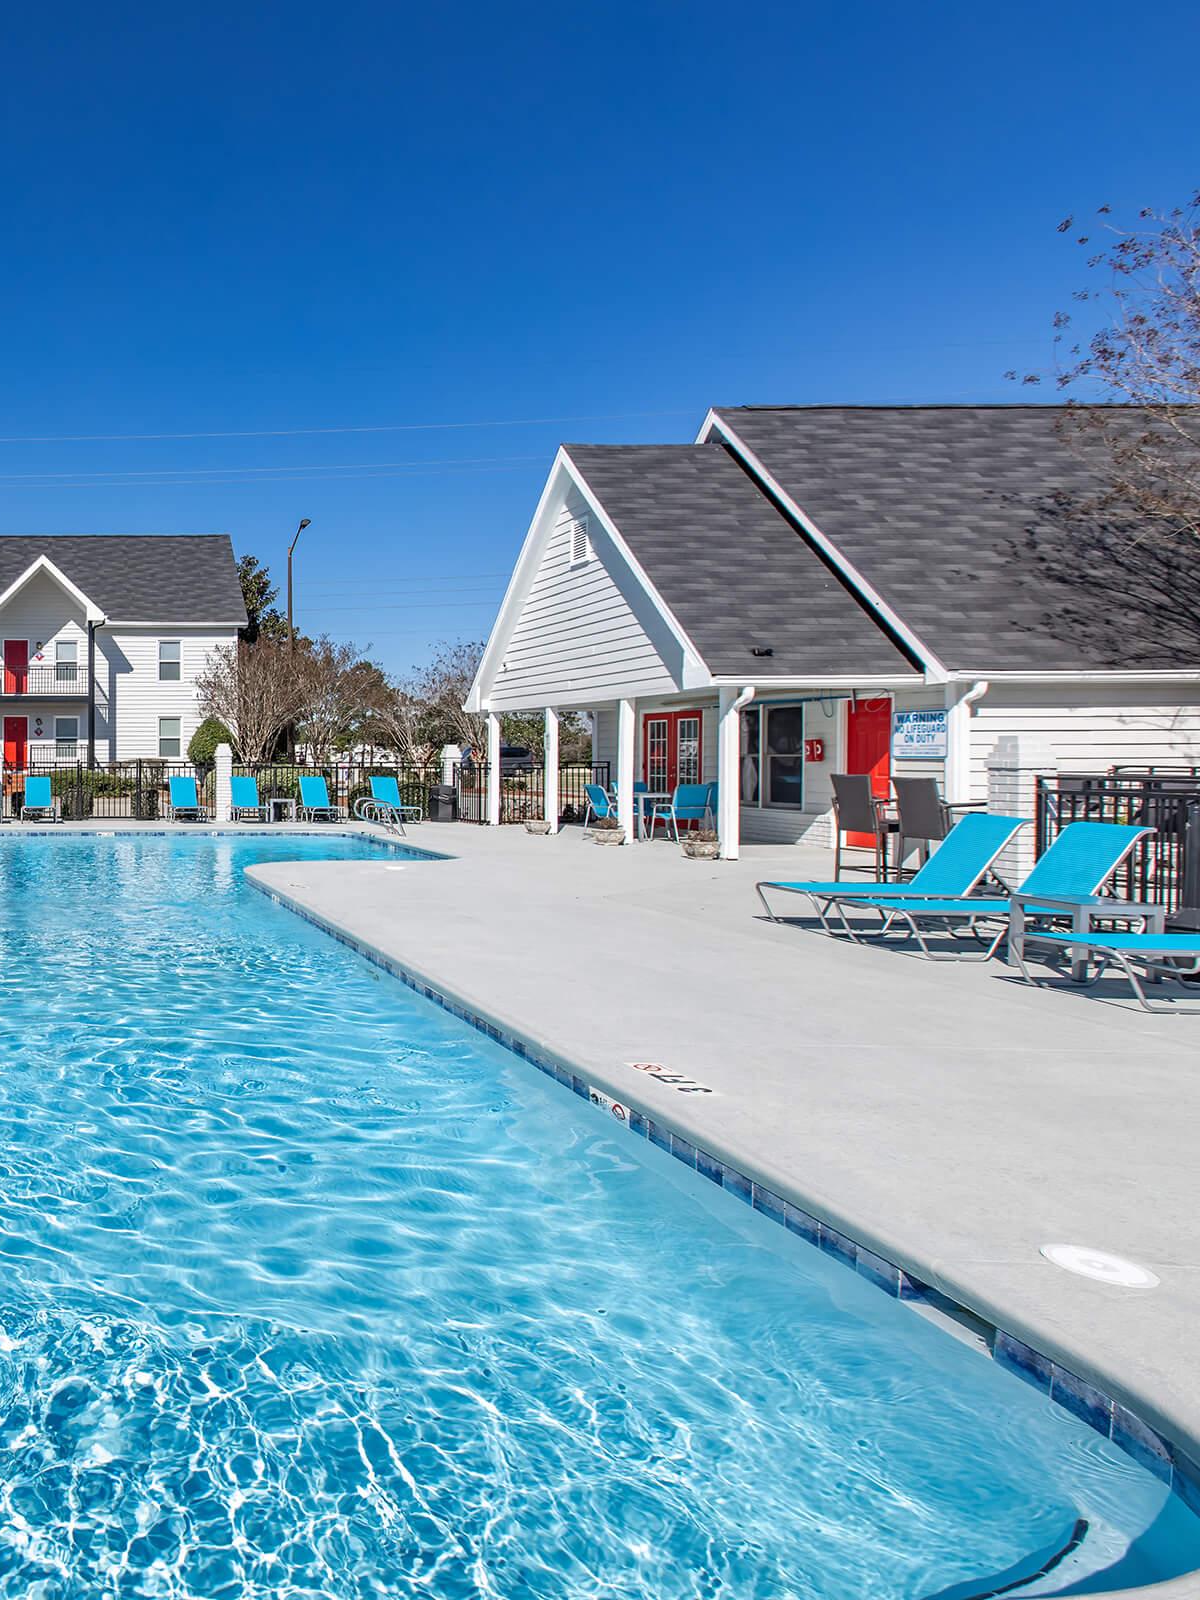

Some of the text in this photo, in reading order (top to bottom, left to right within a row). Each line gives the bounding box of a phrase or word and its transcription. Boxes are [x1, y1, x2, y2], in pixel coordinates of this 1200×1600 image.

[897, 713, 944, 723] WARNING
[895, 724, 946, 734] NO LIFEGUARD
[904, 734, 935, 743] ON DUTY
